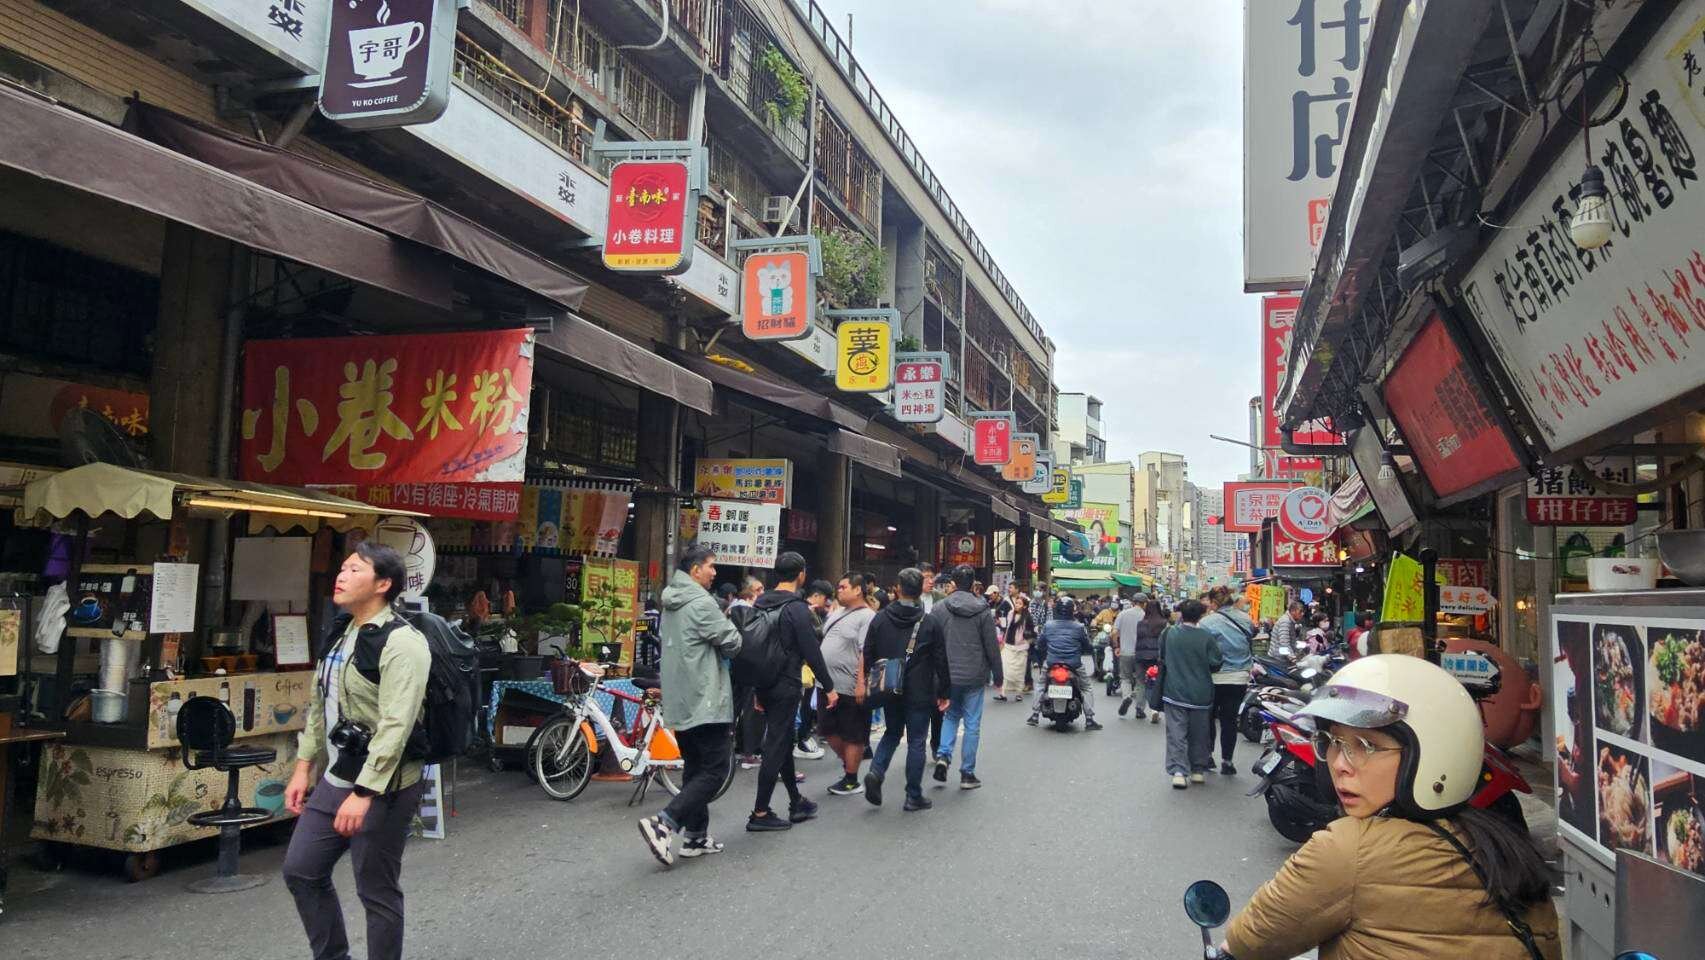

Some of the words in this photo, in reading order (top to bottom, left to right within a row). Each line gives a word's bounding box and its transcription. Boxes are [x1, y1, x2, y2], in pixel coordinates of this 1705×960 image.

[359, 37, 402, 63] 宇哥
[374, 95, 398, 105] COFFEE
[613, 228, 674, 245] 小卷料理
[241, 358, 523, 472] 小卷米粉
[901, 404, 935, 415] 四神湯
[1536, 499, 1628, 521] 柑仔店
[1276, 540, 1338, 563] 蚵仔煎
[96, 767, 143, 782] espresso
